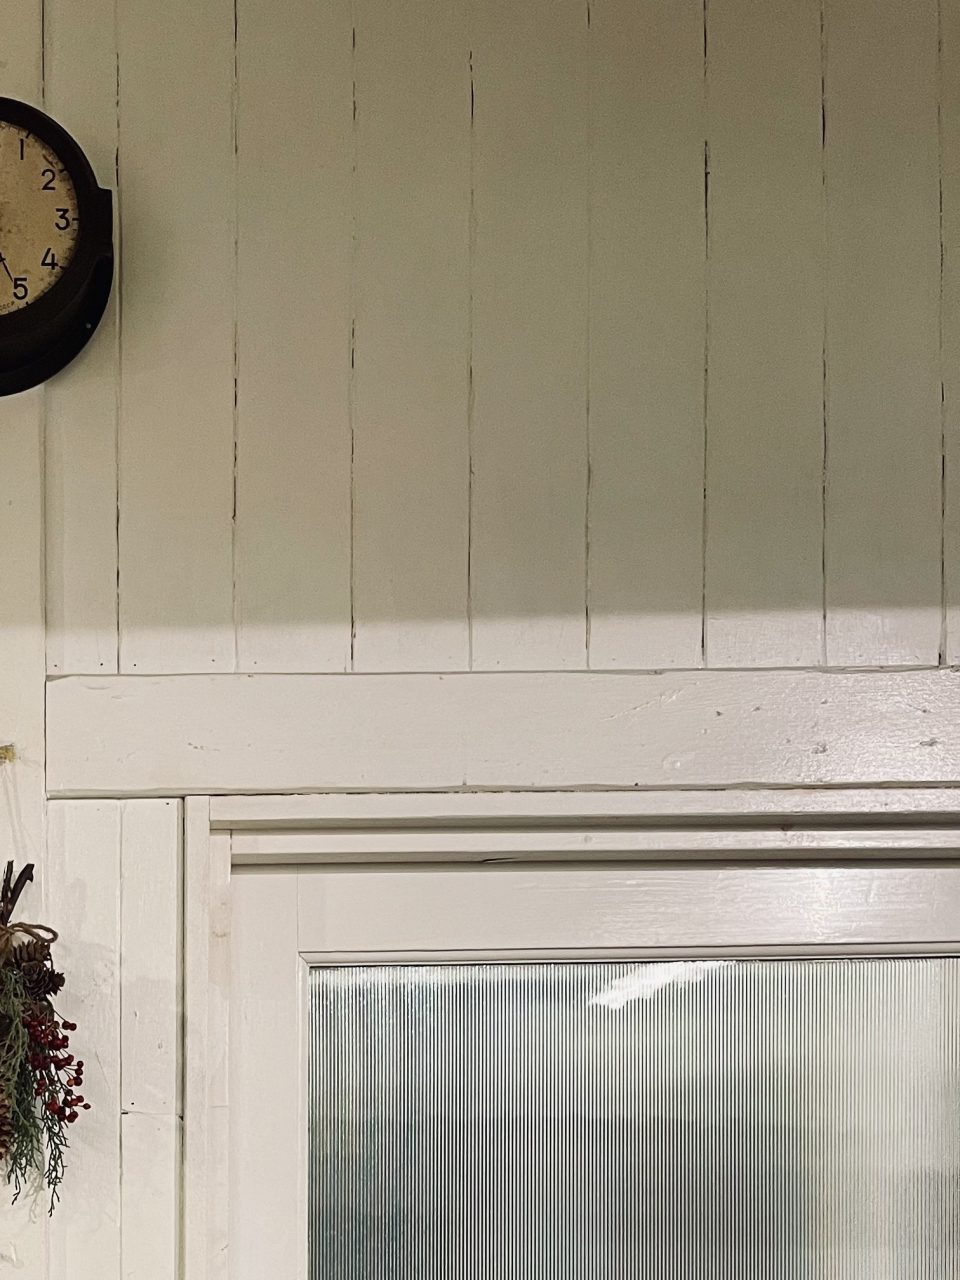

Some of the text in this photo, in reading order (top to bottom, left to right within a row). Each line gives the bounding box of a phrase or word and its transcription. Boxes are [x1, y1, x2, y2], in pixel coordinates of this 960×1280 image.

[20, 138, 25, 160] 1
[41, 169, 56, 190] 2
[55, 208, 70, 230] 3
[41, 248, 59, 270] 4
[13, 278, 28, 300] 5
